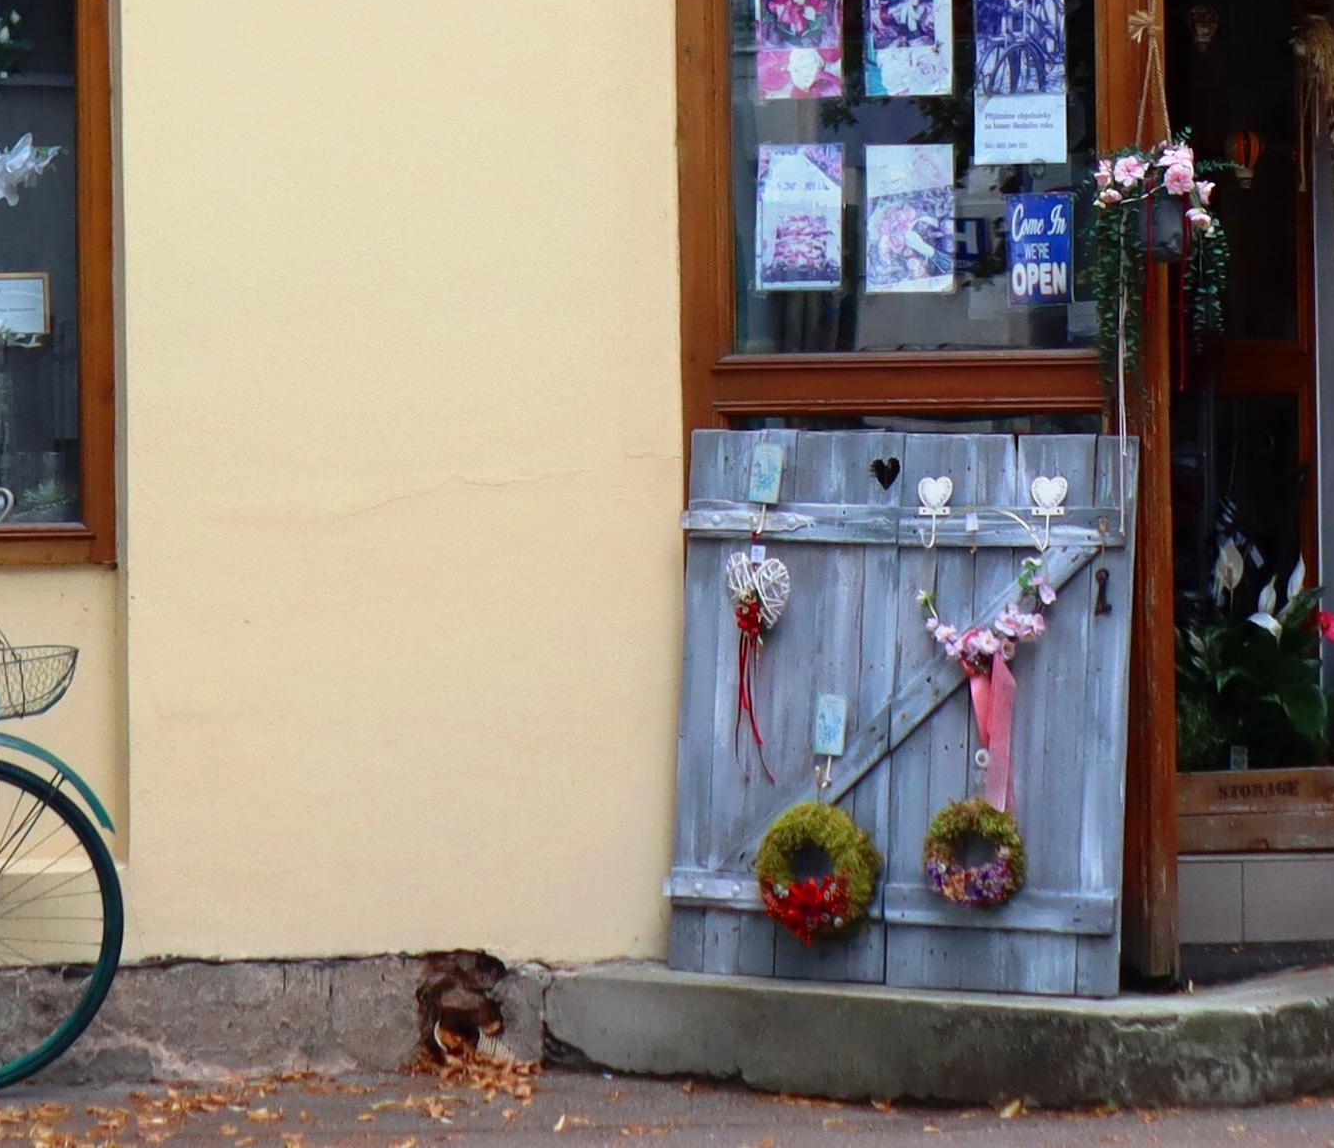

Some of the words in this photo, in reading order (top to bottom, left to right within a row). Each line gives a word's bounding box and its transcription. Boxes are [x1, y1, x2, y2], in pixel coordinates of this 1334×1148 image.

[1011, 203, 1045, 243] Come
[1047, 204, 1067, 236] In
[1024, 242, 1050, 260] WE'RE
[1011, 261, 1067, 297] OPEN
[1218, 780, 1300, 801] STORAGE
